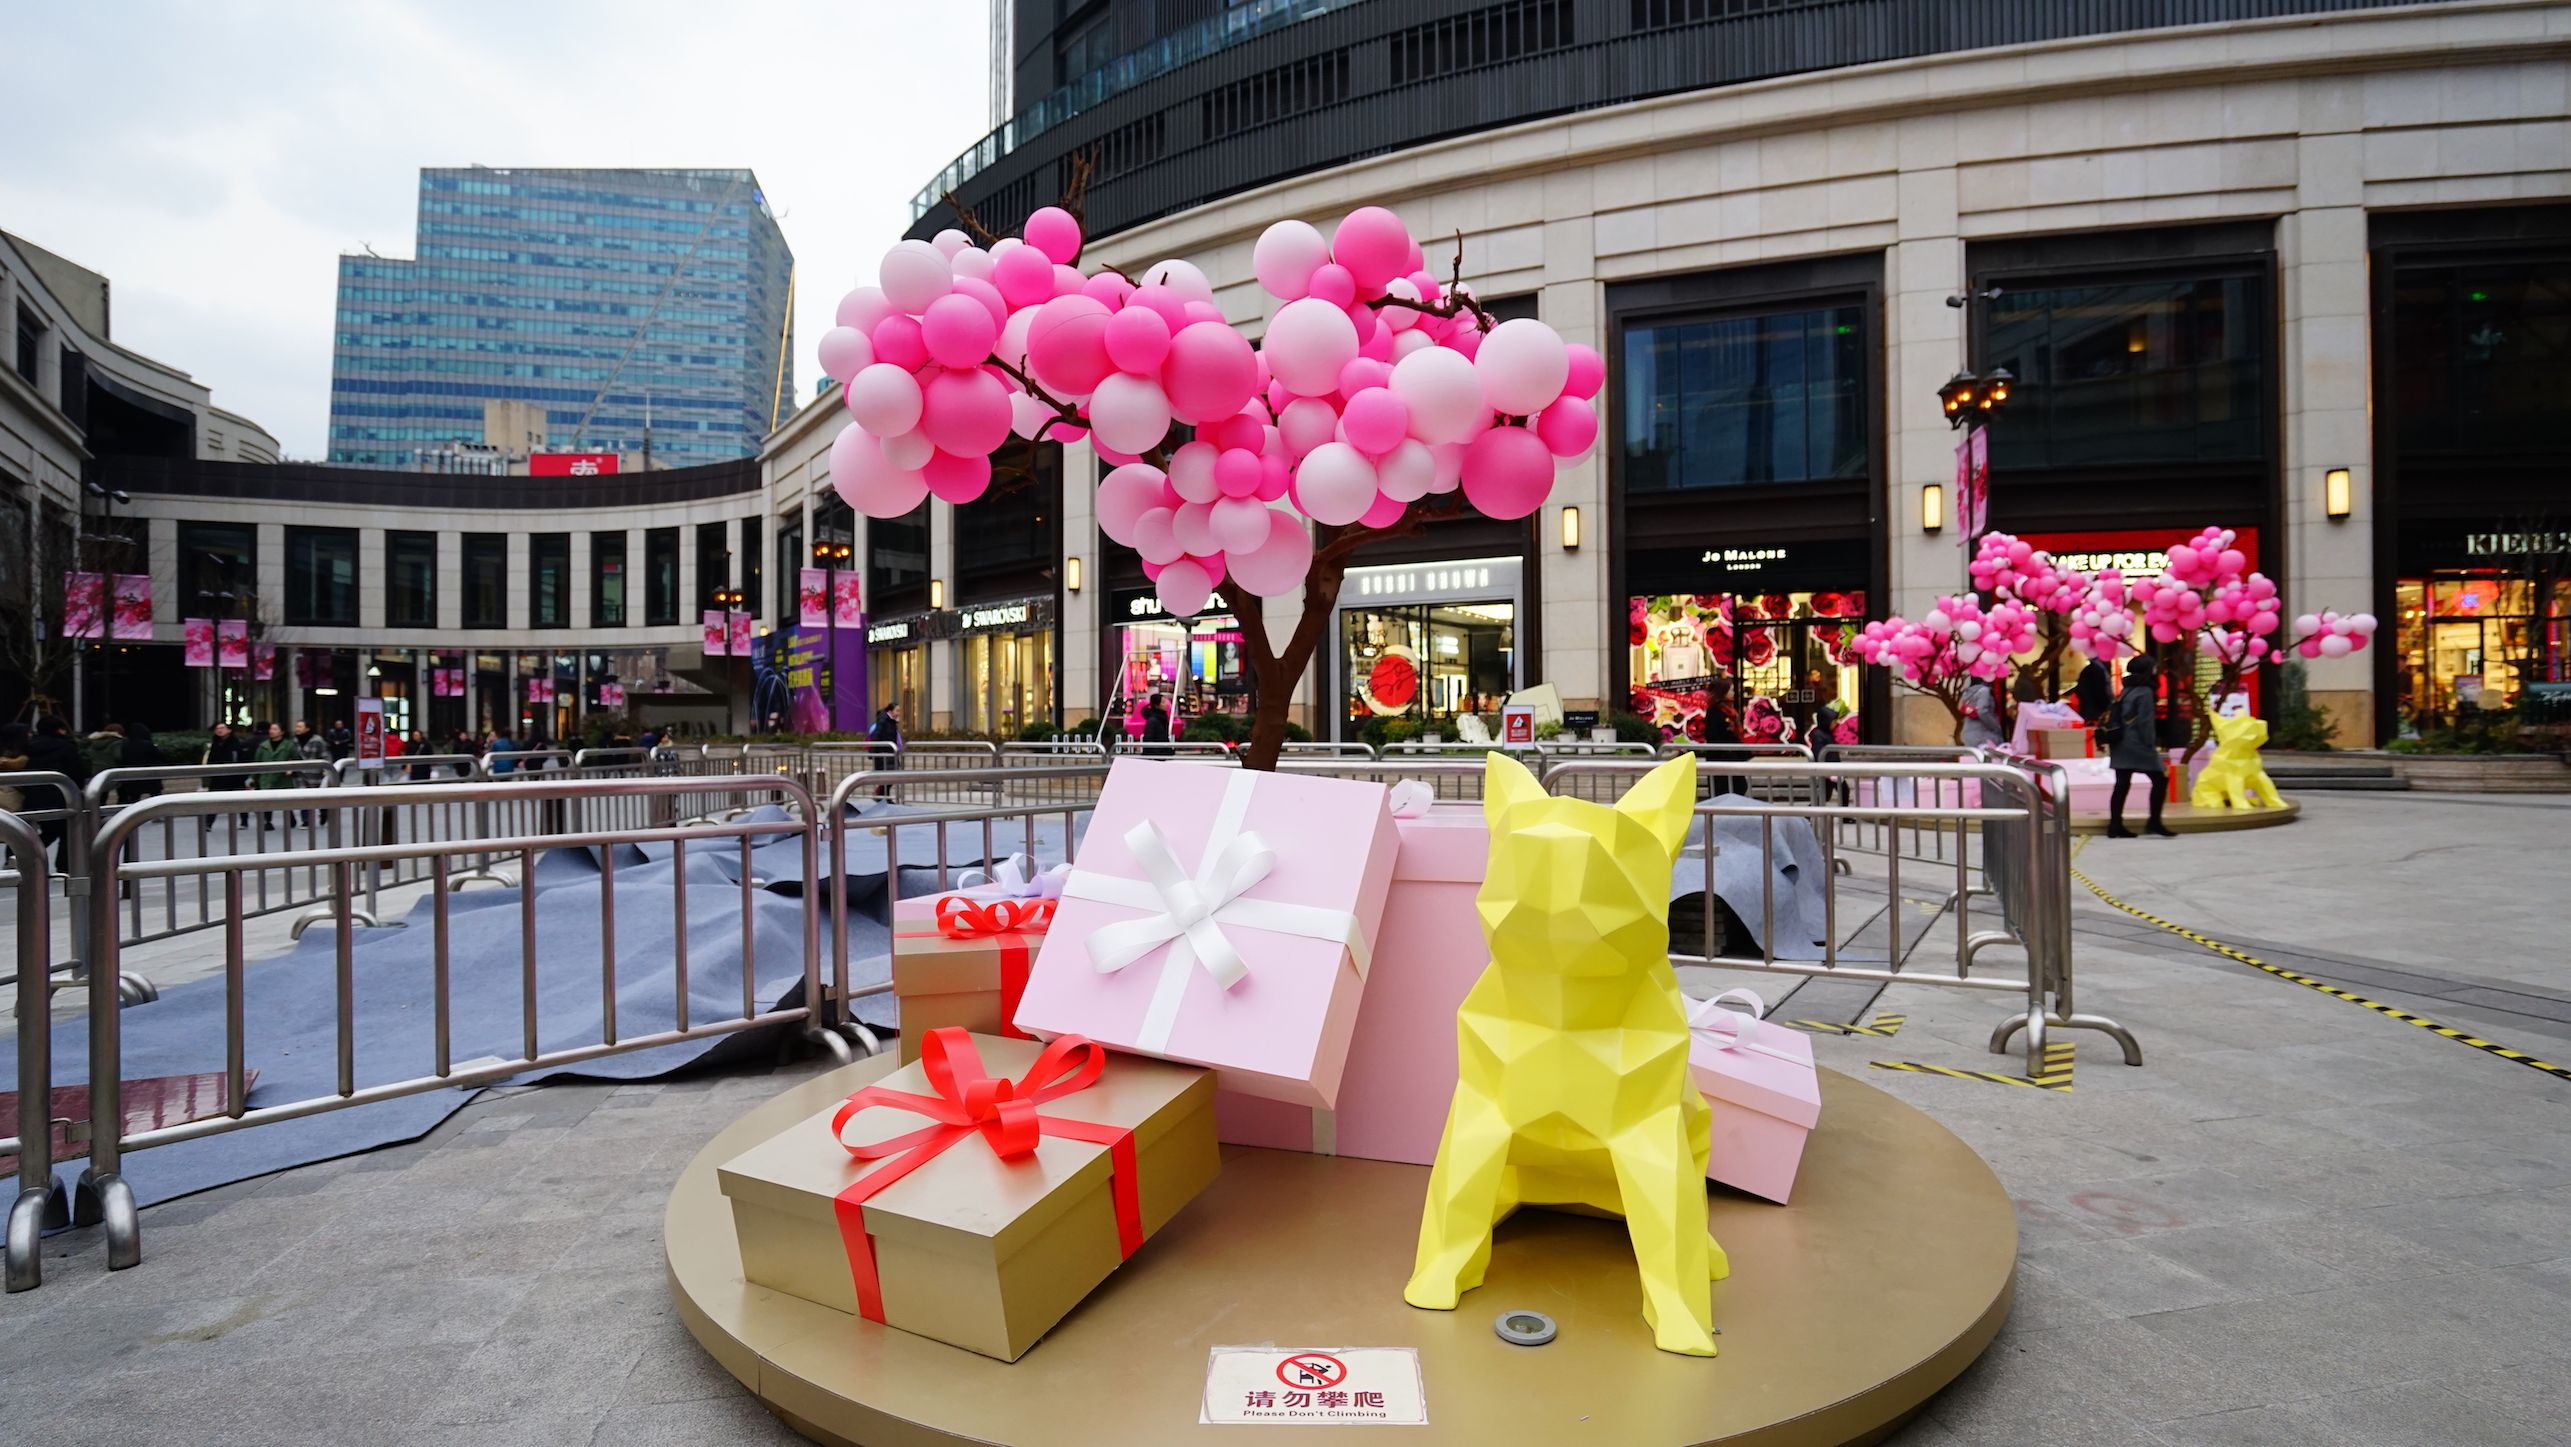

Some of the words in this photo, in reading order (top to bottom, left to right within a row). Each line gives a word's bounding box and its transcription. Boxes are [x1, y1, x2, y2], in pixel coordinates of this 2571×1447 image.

[2089, 554, 2112, 571] UP
[2113, 552, 2146, 570] FOR
[973, 605, 1026, 627] SWAROVSKI
[1245, 1391, 1384, 1408] 请勿攀爬
[1327, 1410, 1387, 1418] Climbing
